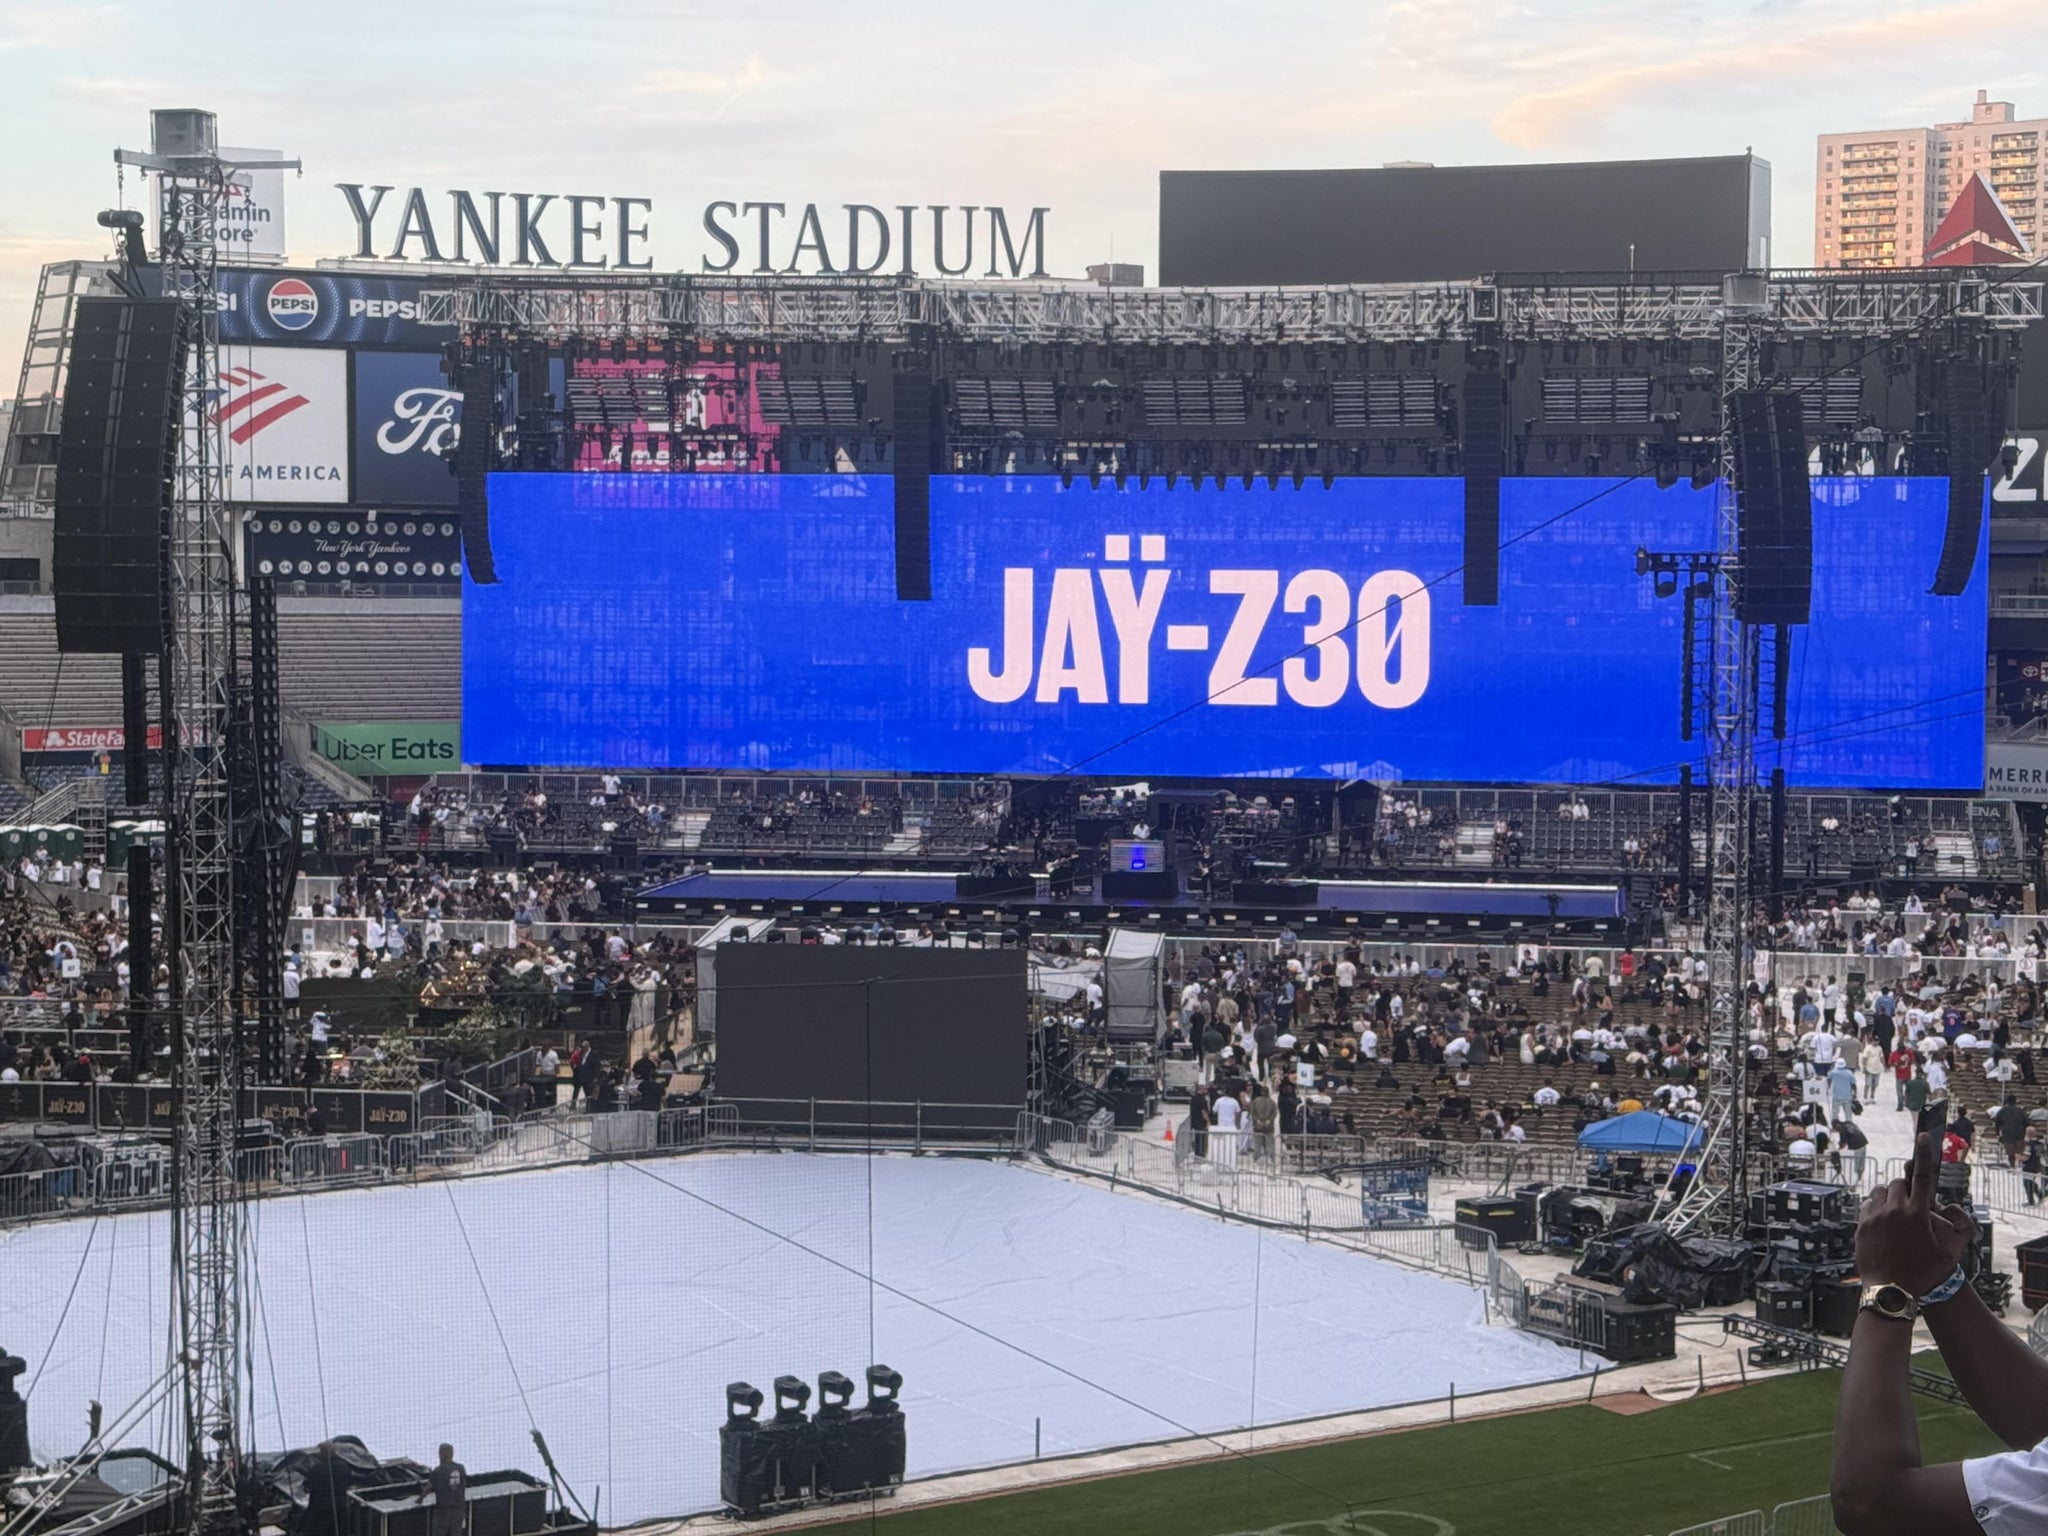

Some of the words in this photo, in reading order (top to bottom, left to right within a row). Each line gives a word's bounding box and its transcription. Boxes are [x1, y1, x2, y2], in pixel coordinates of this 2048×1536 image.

[334, 183, 654, 271] YANKEE
[701, 201, 1050, 278] STADIUM
[271, 298, 315, 311] PEPSI
[350, 300, 422, 319] PEPSI
[240, 464, 341, 480] AMERICA
[314, 539, 339, 552] New
[339, 539, 365, 557] York
[365, 540, 411, 558] Yankees
[326, 738, 386, 760] Uber
[392, 738, 454, 759] Eats
[1996, 785, 2019, 793] BANK
[2021, 786, 2032, 794] OF
